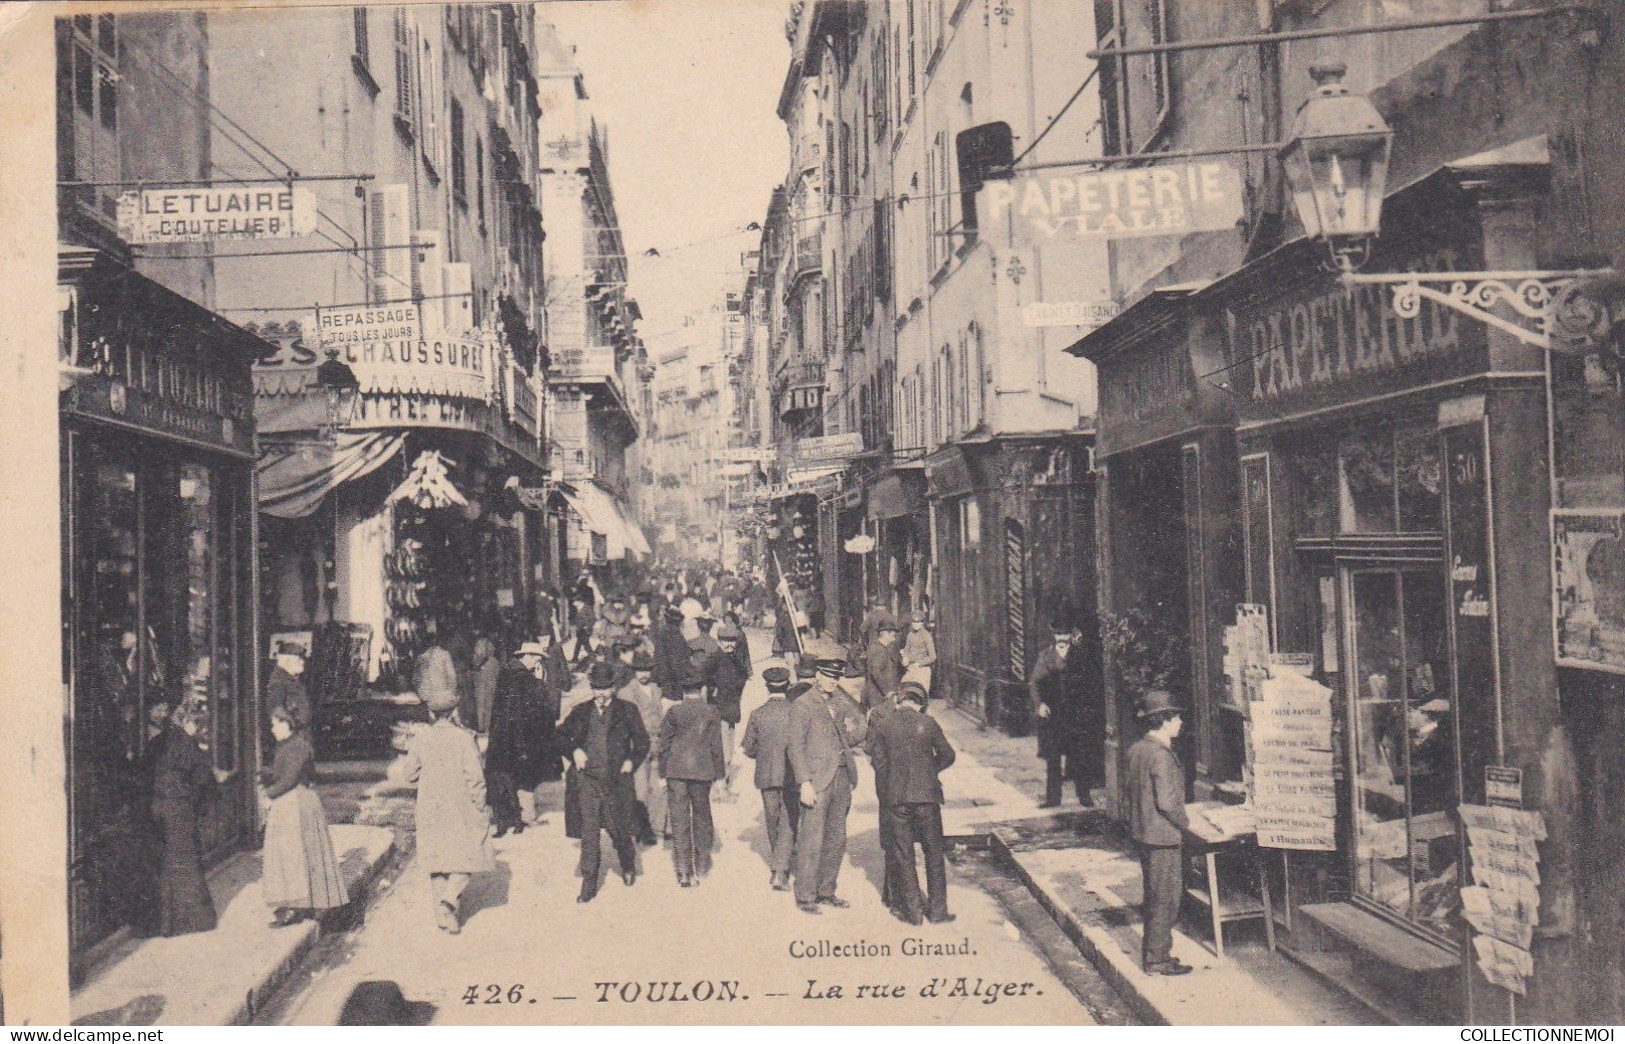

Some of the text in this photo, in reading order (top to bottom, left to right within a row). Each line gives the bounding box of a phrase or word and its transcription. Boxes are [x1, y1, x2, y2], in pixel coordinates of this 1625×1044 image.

[987, 164, 1224, 217] PAPETERIE
[145, 192, 293, 214] LETUAIRE
[1030, 207, 1186, 236] VIALE
[322, 308, 415, 328] REPASSAGE
[331, 326, 412, 343] TOUS LES JOURS
